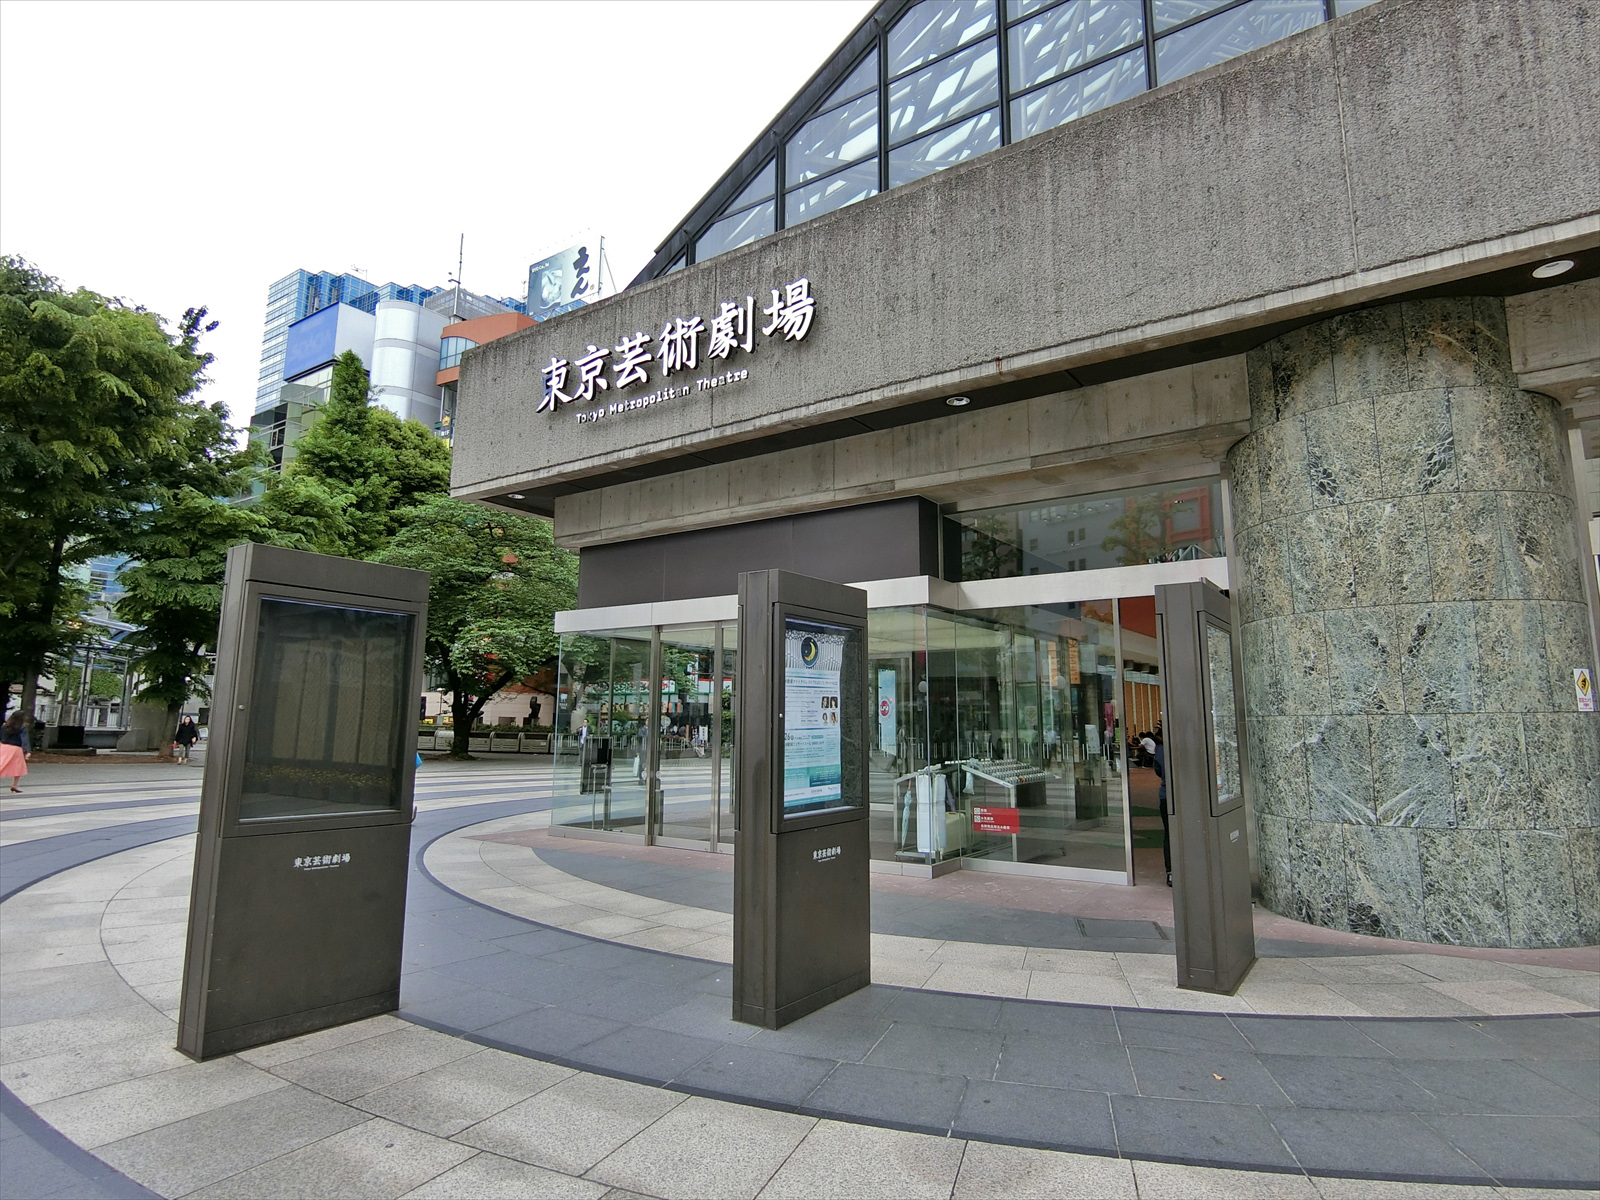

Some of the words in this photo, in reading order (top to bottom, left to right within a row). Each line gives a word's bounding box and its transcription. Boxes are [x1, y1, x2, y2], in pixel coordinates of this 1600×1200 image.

[536, 277, 816, 413] 東京芸術劇場
[576, 408, 605, 424] Tokyo
[609, 385, 690, 415] Metropolitan
[697, 368, 748, 391] Theatre
[293, 853, 351, 868] 東京芸術劇場
